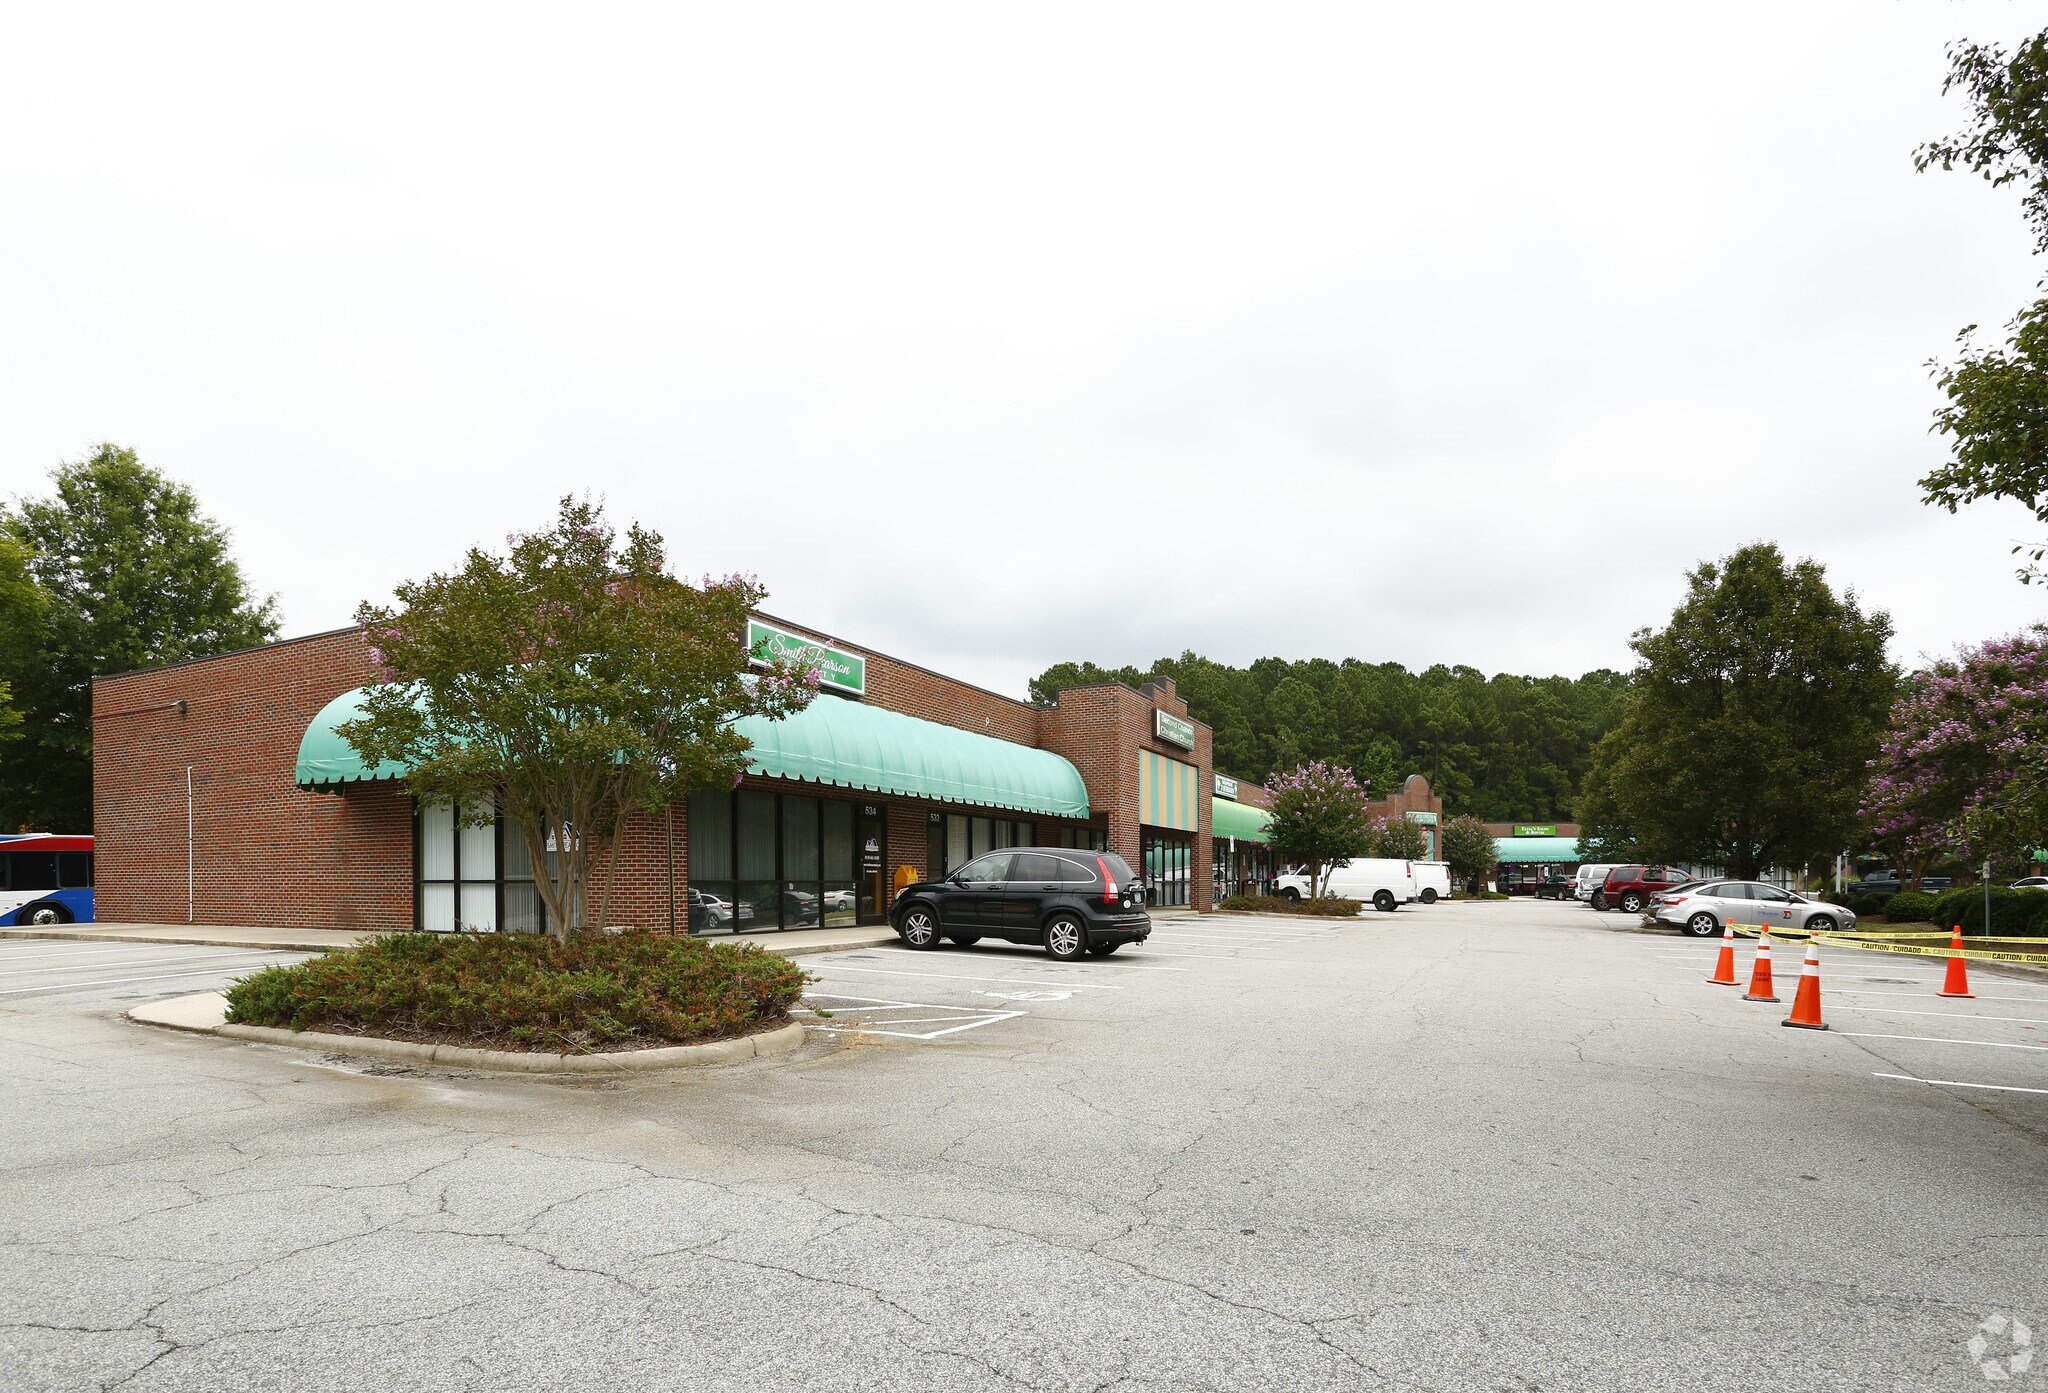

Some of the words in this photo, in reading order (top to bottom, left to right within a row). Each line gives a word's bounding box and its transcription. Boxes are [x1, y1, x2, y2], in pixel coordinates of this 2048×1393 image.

[807, 646, 851, 675] Pearson
[1161, 714, 1178, 729] Second
[864, 806, 877, 816] 534
[930, 813, 940, 822] 532
